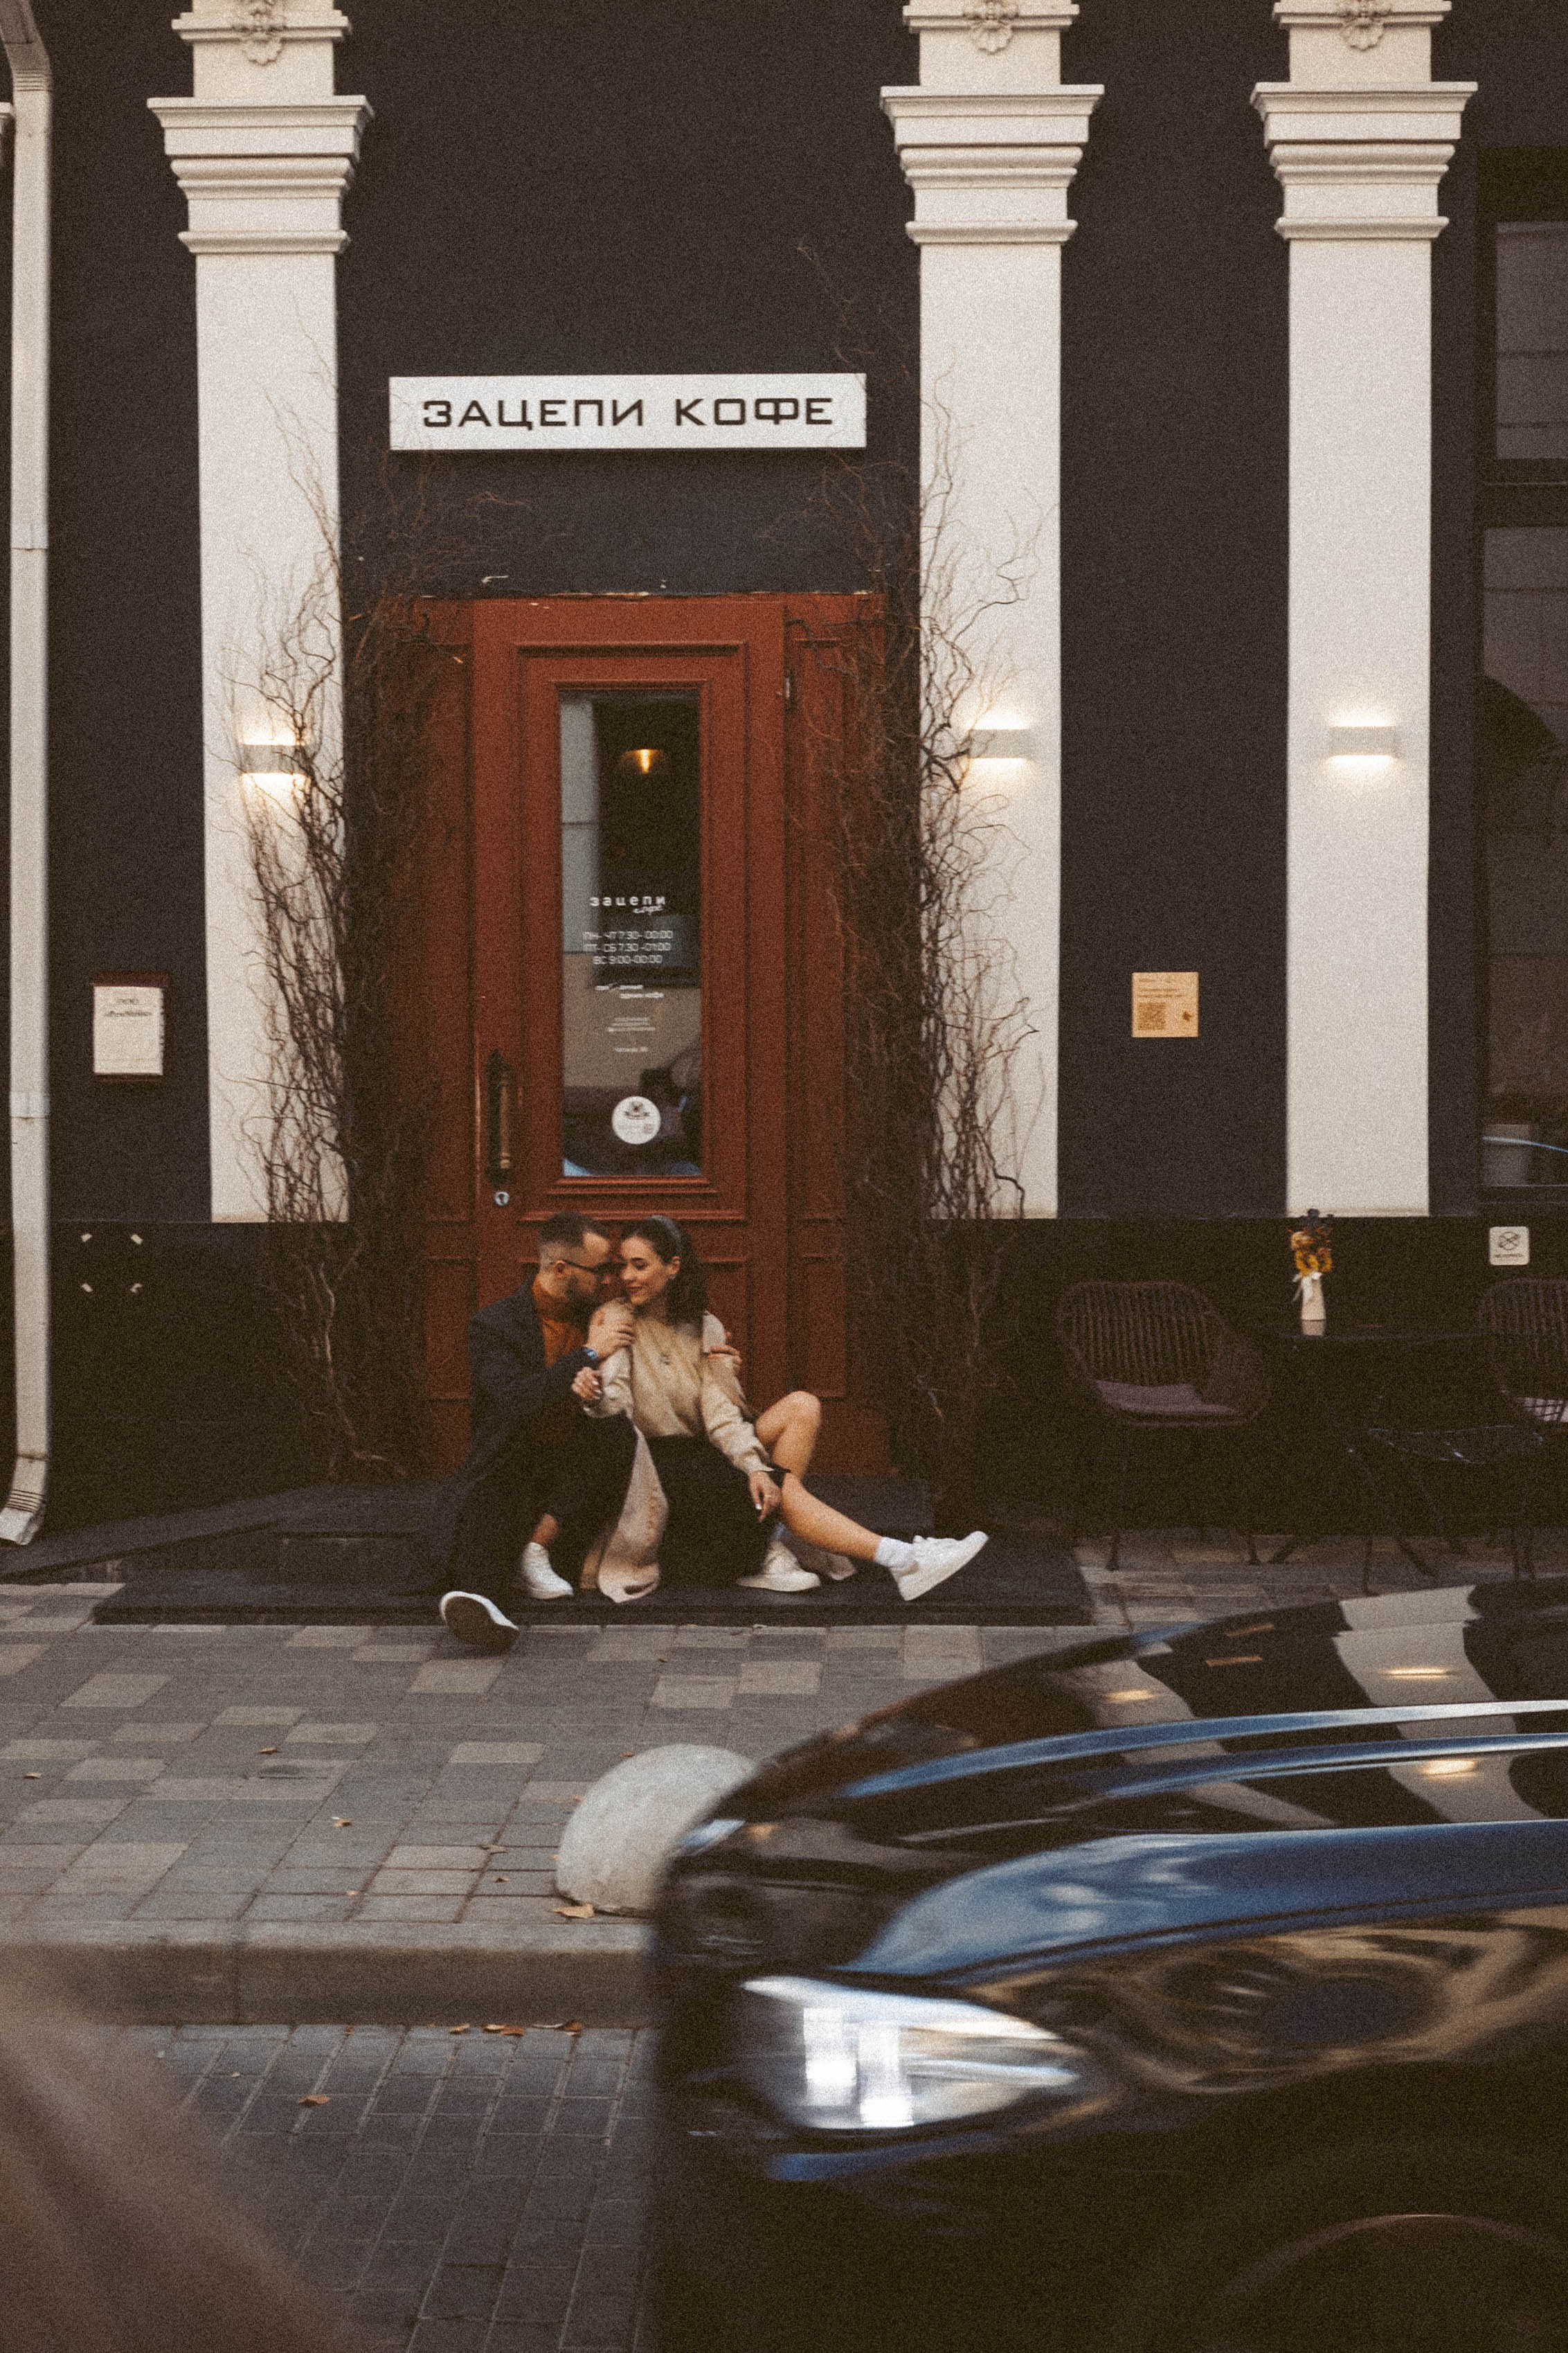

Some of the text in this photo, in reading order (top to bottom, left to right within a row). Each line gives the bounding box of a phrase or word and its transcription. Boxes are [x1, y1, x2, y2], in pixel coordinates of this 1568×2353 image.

[423, 397, 832, 430] ЗАЦЕПИ КОФЕ
[590, 896, 665, 906] зацепи
